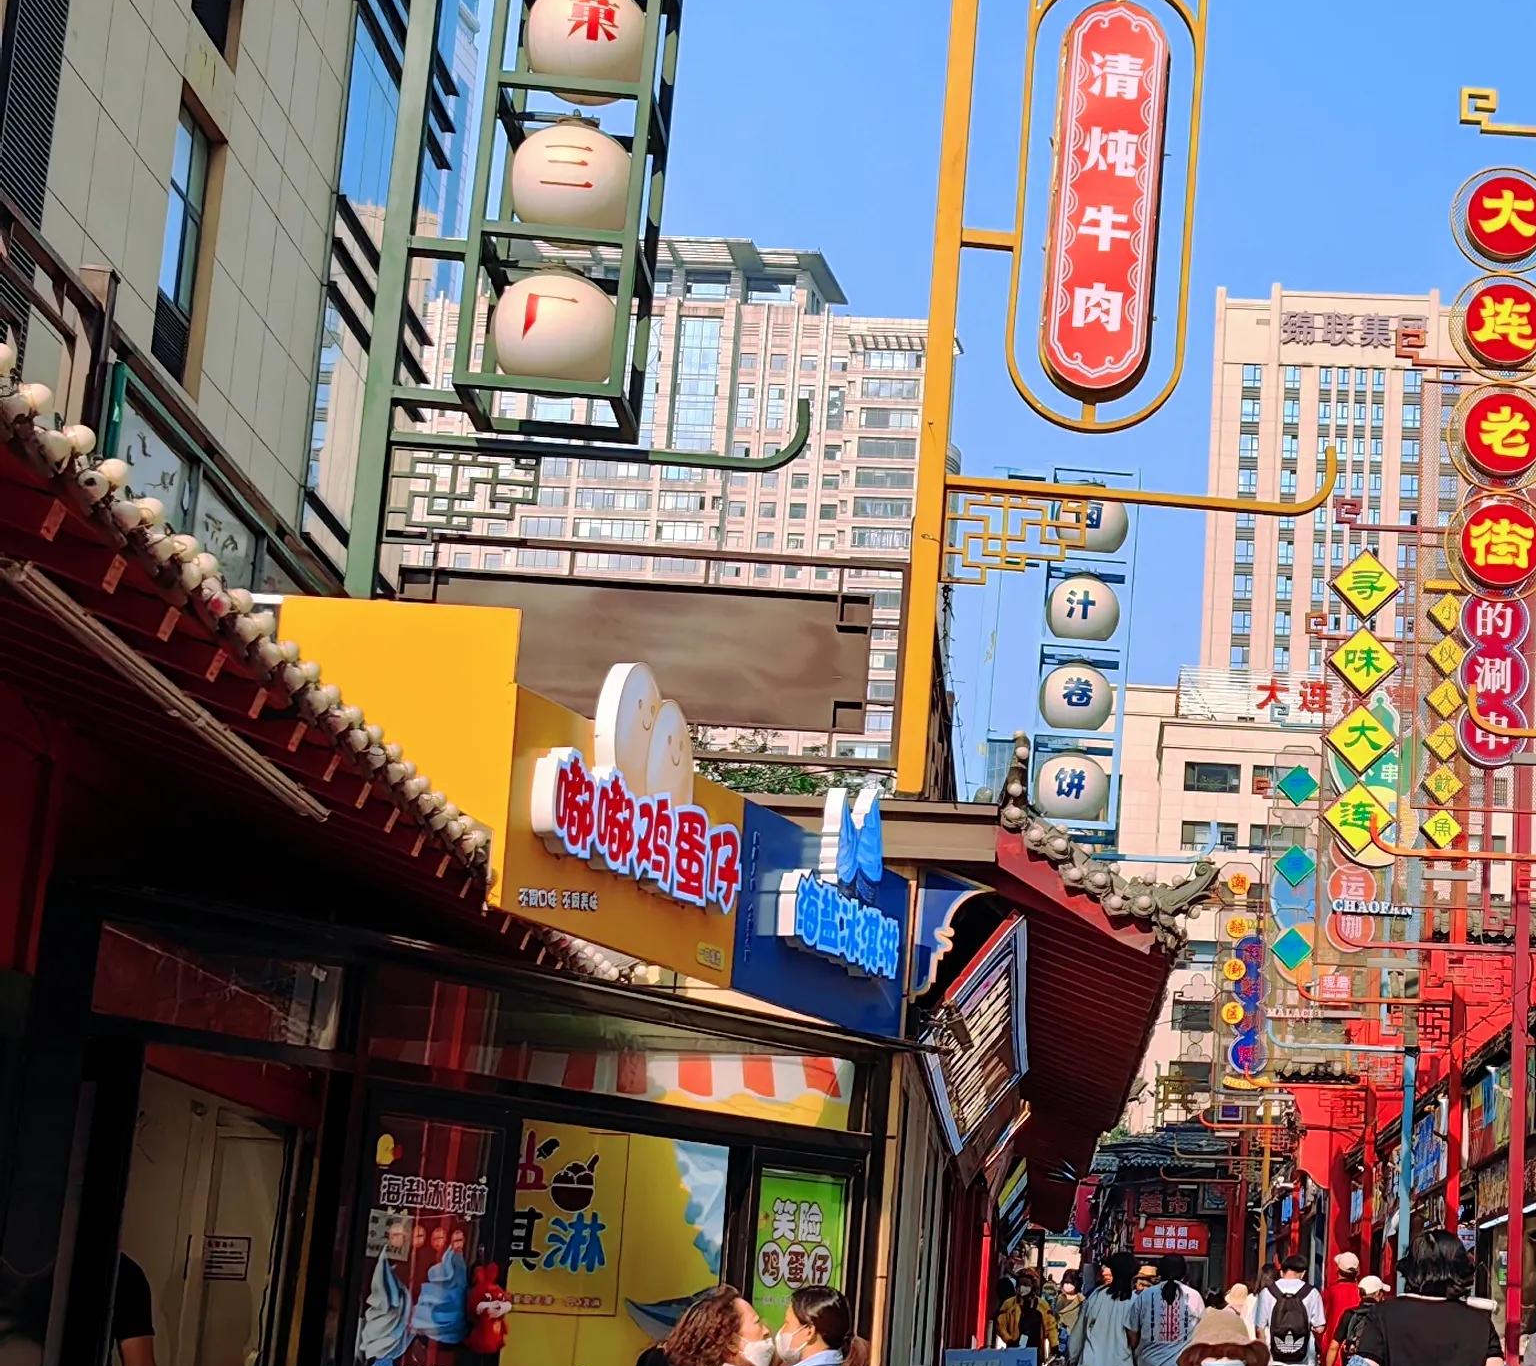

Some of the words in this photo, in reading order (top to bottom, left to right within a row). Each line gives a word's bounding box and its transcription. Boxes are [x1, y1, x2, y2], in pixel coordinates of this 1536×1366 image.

[1071, 51, 1144, 332] 清炖牛肉
[1337, 568, 1388, 832] 寻味大连
[555, 754, 742, 915] 嘟嘟鸡蛋仔
[796, 874, 899, 979] 海盐冰淇淋
[379, 1174, 489, 1217] 海盐冰淇淋
[760, 1245, 832, 1288] 鸡蛋仔
